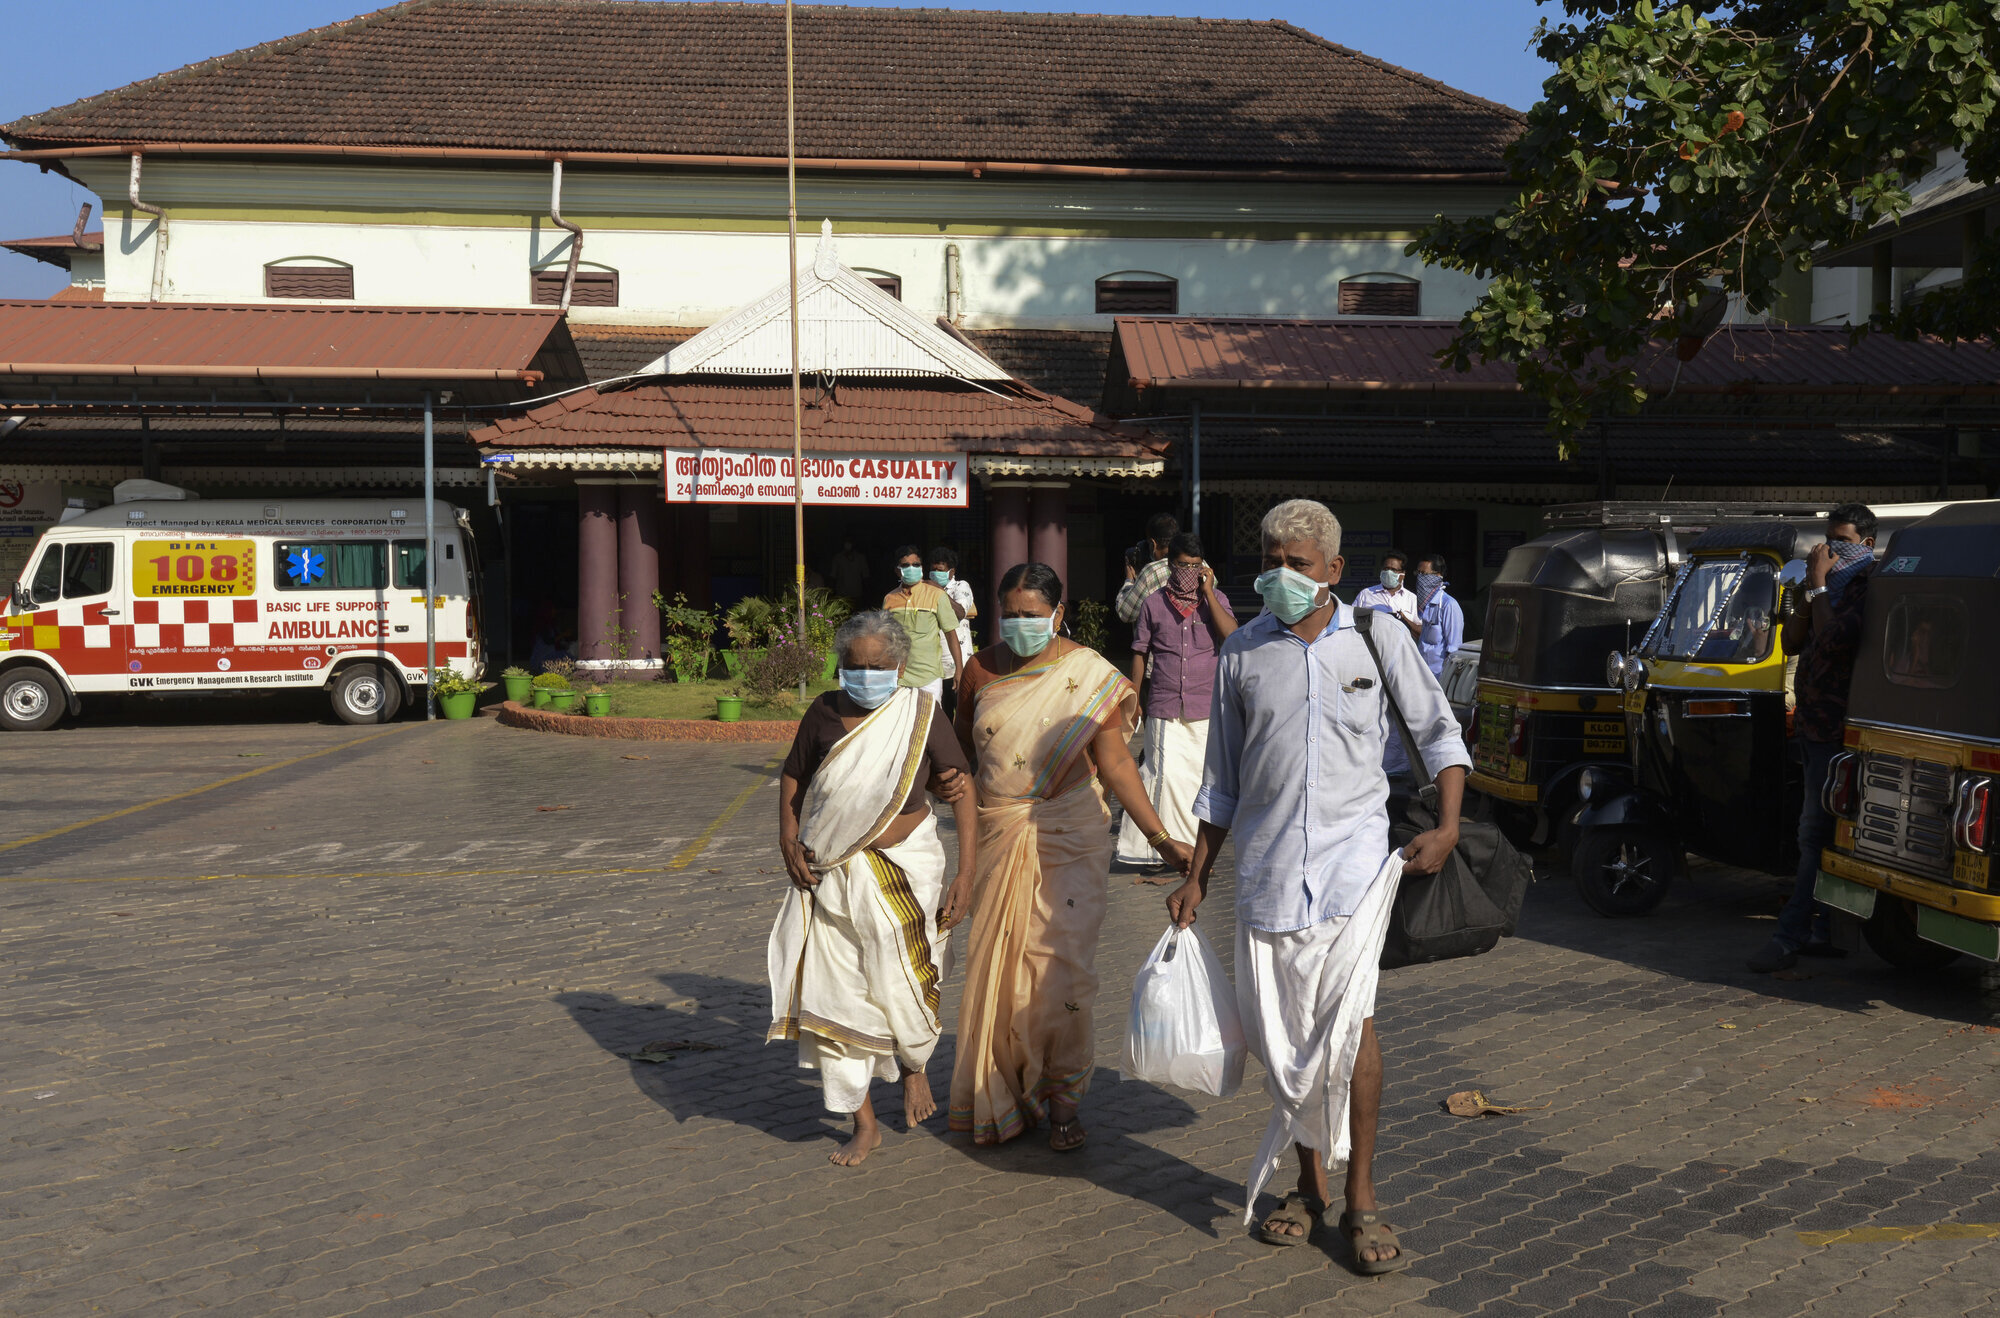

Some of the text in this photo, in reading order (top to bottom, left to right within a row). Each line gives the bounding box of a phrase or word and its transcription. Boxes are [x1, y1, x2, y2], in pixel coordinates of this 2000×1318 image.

[675, 452, 957, 481] അത്യാഹിത വഭാഗം CASUALTY
[676, 483, 692, 495] 24
[757, 484, 804, 497] സേവന
[873, 486, 902, 499] 0487
[906, 486, 957, 499] 2427383
[126, 519, 157, 527] Project
[160, 519, 199, 528] Managed
[149, 554, 238, 582] 108
[151, 584, 236, 595] EMERGENCY
[266, 601, 390, 613] BASIC LIFE SUPPORT
[267, 619, 391, 639] AMBULANCE
[129, 677, 154, 687] GVK
[156, 676, 195, 686] Emergency
[197, 675, 243, 685] Management
[249, 674, 283, 683] Research
[406, 673, 425, 681] GVK
